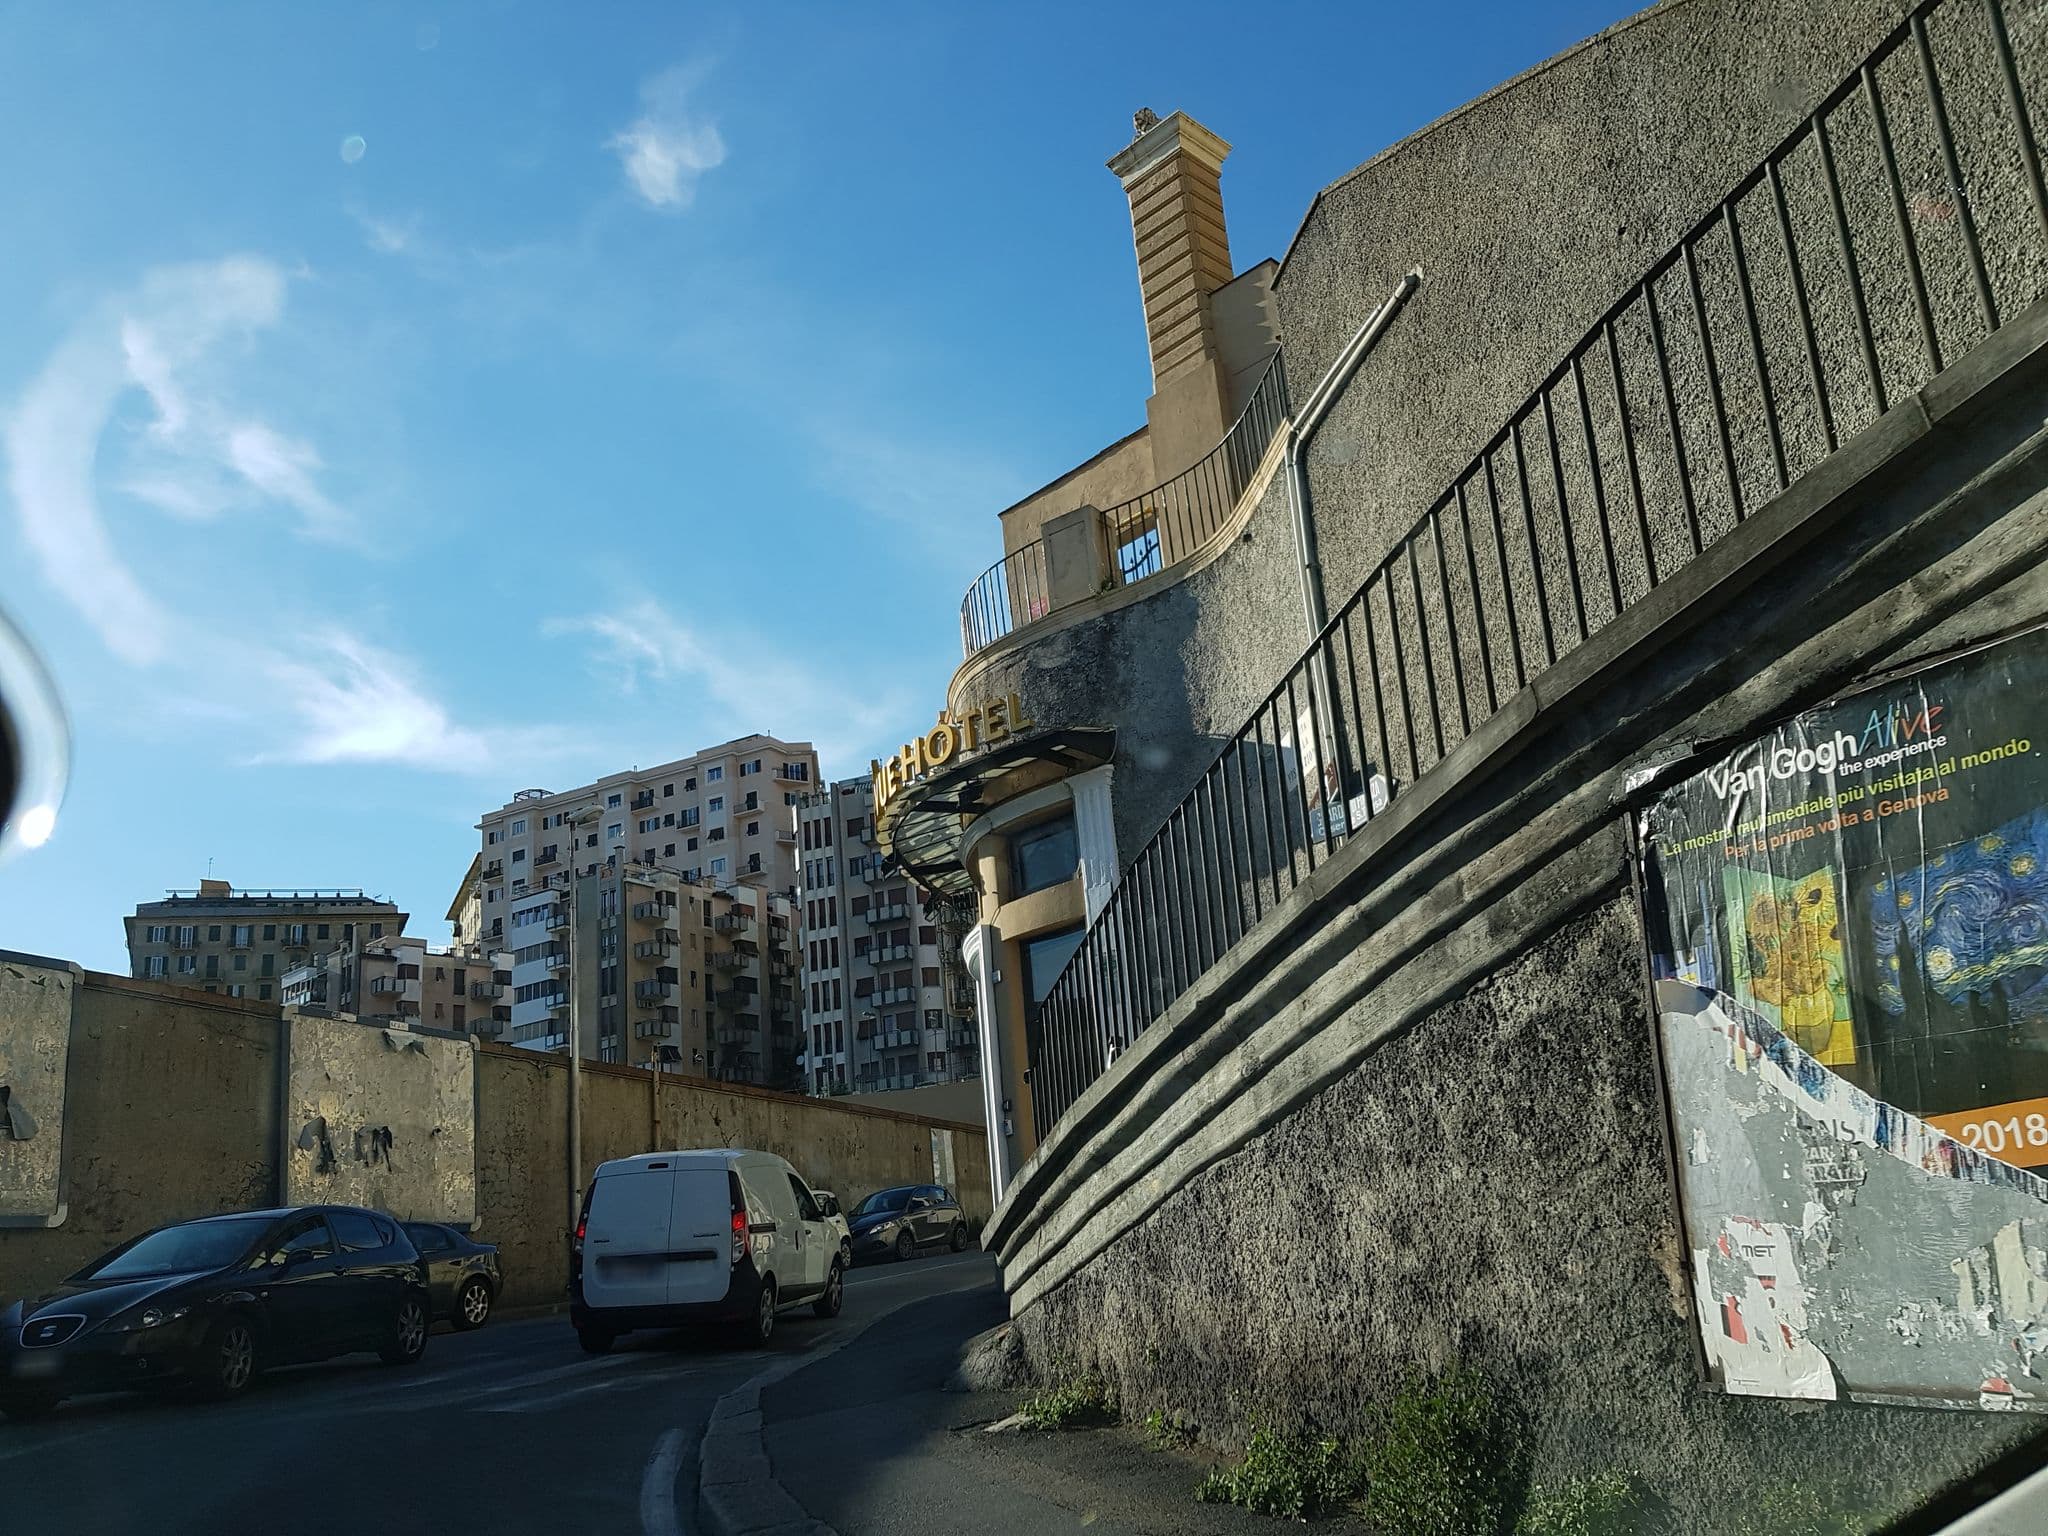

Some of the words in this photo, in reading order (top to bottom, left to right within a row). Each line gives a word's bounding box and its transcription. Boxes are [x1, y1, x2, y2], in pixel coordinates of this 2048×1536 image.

[1708, 764, 1765, 799] Van
[1773, 730, 1857, 779] Gogh
[1858, 704, 1944, 755] Alive
[1838, 761, 1863, 777] the
[1864, 735, 1948, 768] experience
[1663, 841, 1681, 856] La
[1684, 827, 1733, 850] mostra
[1736, 796, 1834, 834] multimediale
[1837, 784, 1865, 808] più
[1867, 767, 1935, 795] visitata
[1939, 757, 1957, 776] al
[1961, 738, 2031, 770] mondo
[1724, 843, 1750, 859] Per
[1753, 835, 1767, 852] la
[1768, 826, 1815, 852] prima
[1817, 812, 1859, 833] volta
[1863, 808, 1875, 822] a
[1878, 787, 1949, 816] Genova
[1962, 1113, 2048, 1153] 2018
